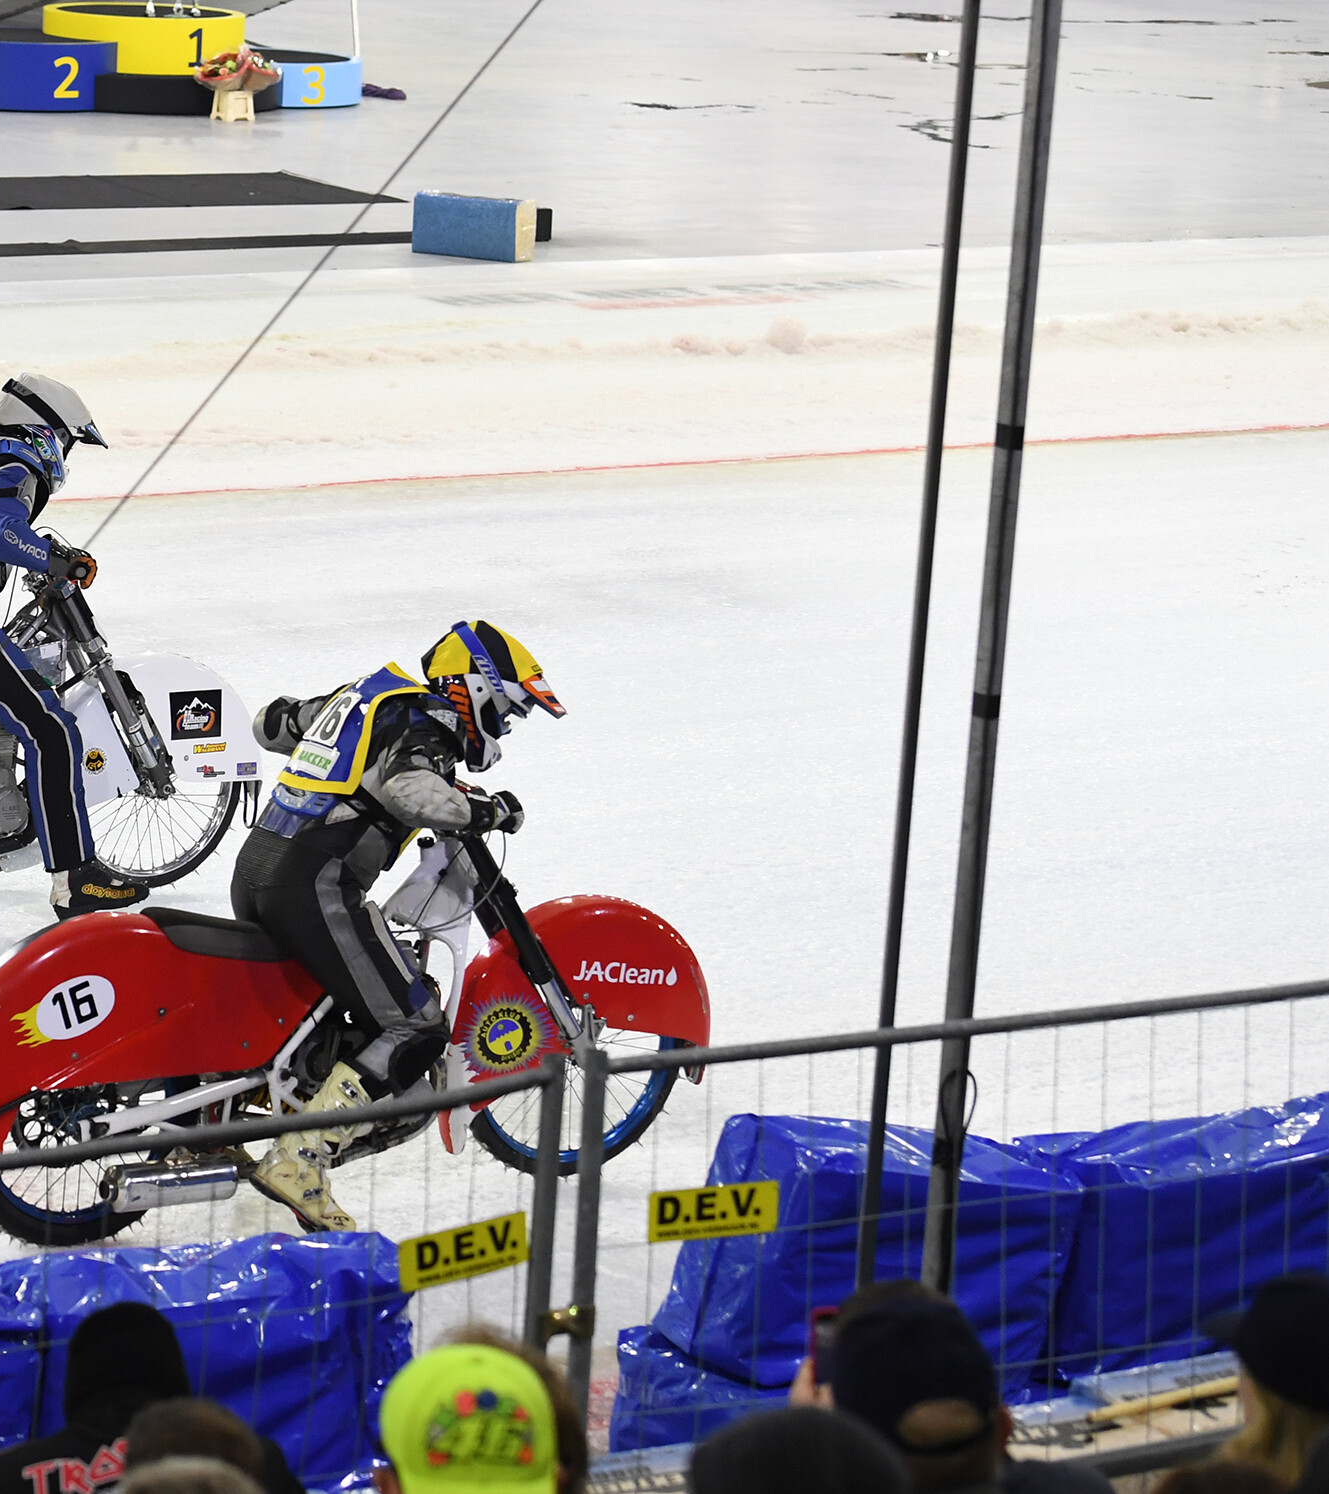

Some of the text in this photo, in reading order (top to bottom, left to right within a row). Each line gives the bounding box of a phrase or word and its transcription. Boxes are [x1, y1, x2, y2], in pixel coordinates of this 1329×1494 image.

[188, 28, 203, 67] 1
[53, 56, 80, 99] 2
[301, 65, 326, 105] 3
[18, 539, 47, 560] WACO
[81, 883, 135, 899] daytona
[51, 980, 99, 1030] 16
[480, 1015, 497, 1038] AUTO
[657, 1188, 761, 1225] D.E.V.
[416, 1220, 518, 1271] D.E.V.
